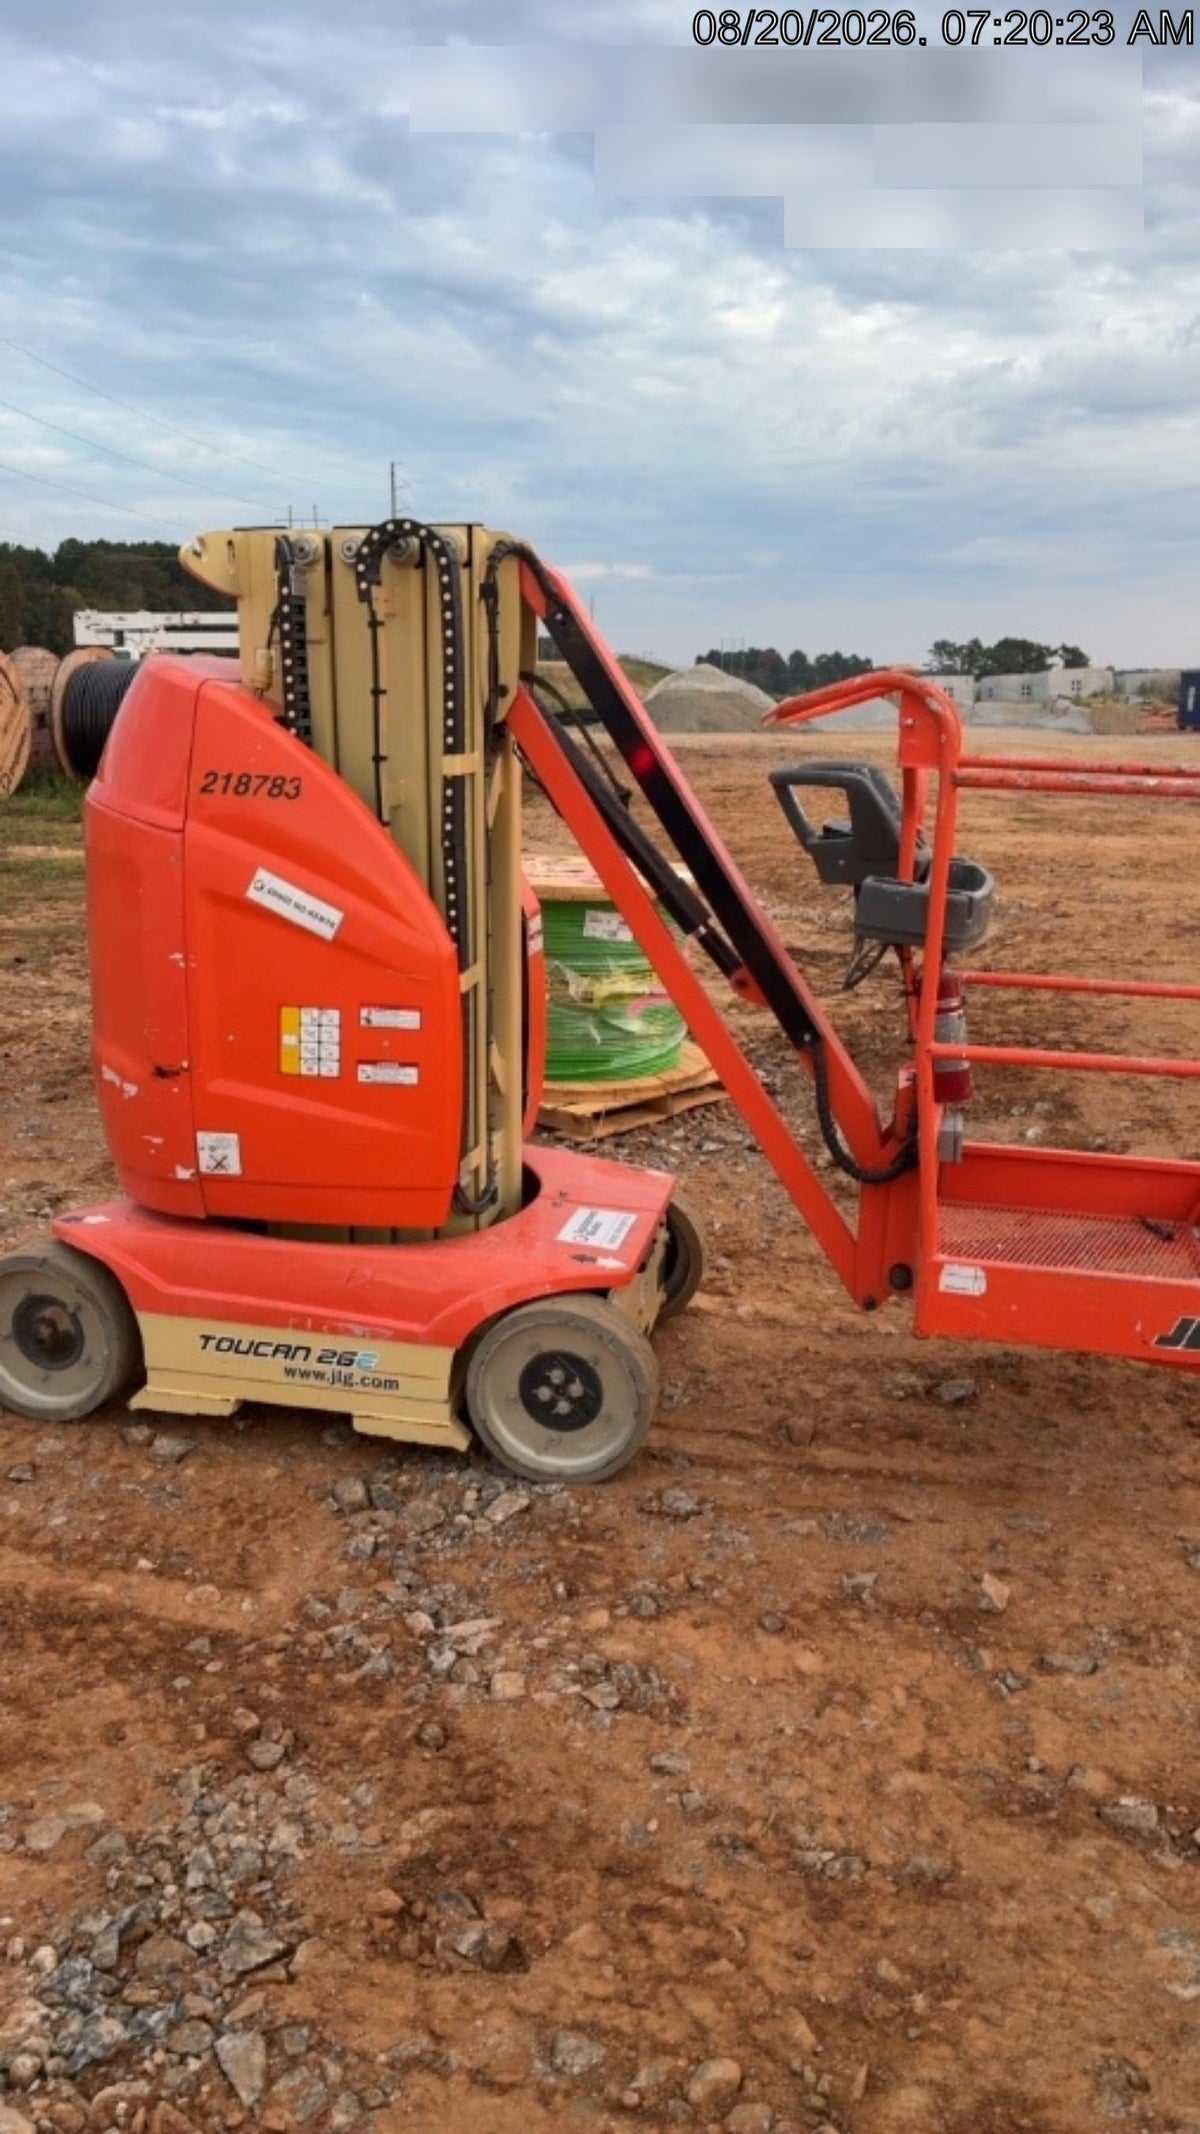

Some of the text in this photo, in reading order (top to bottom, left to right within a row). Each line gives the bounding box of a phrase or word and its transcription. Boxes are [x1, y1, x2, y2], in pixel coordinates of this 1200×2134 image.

[200, 770, 302, 800] 218783
[199, 1333, 312, 1362] TOUCAN
[284, 1366, 400, 1390] www.jlg.com
